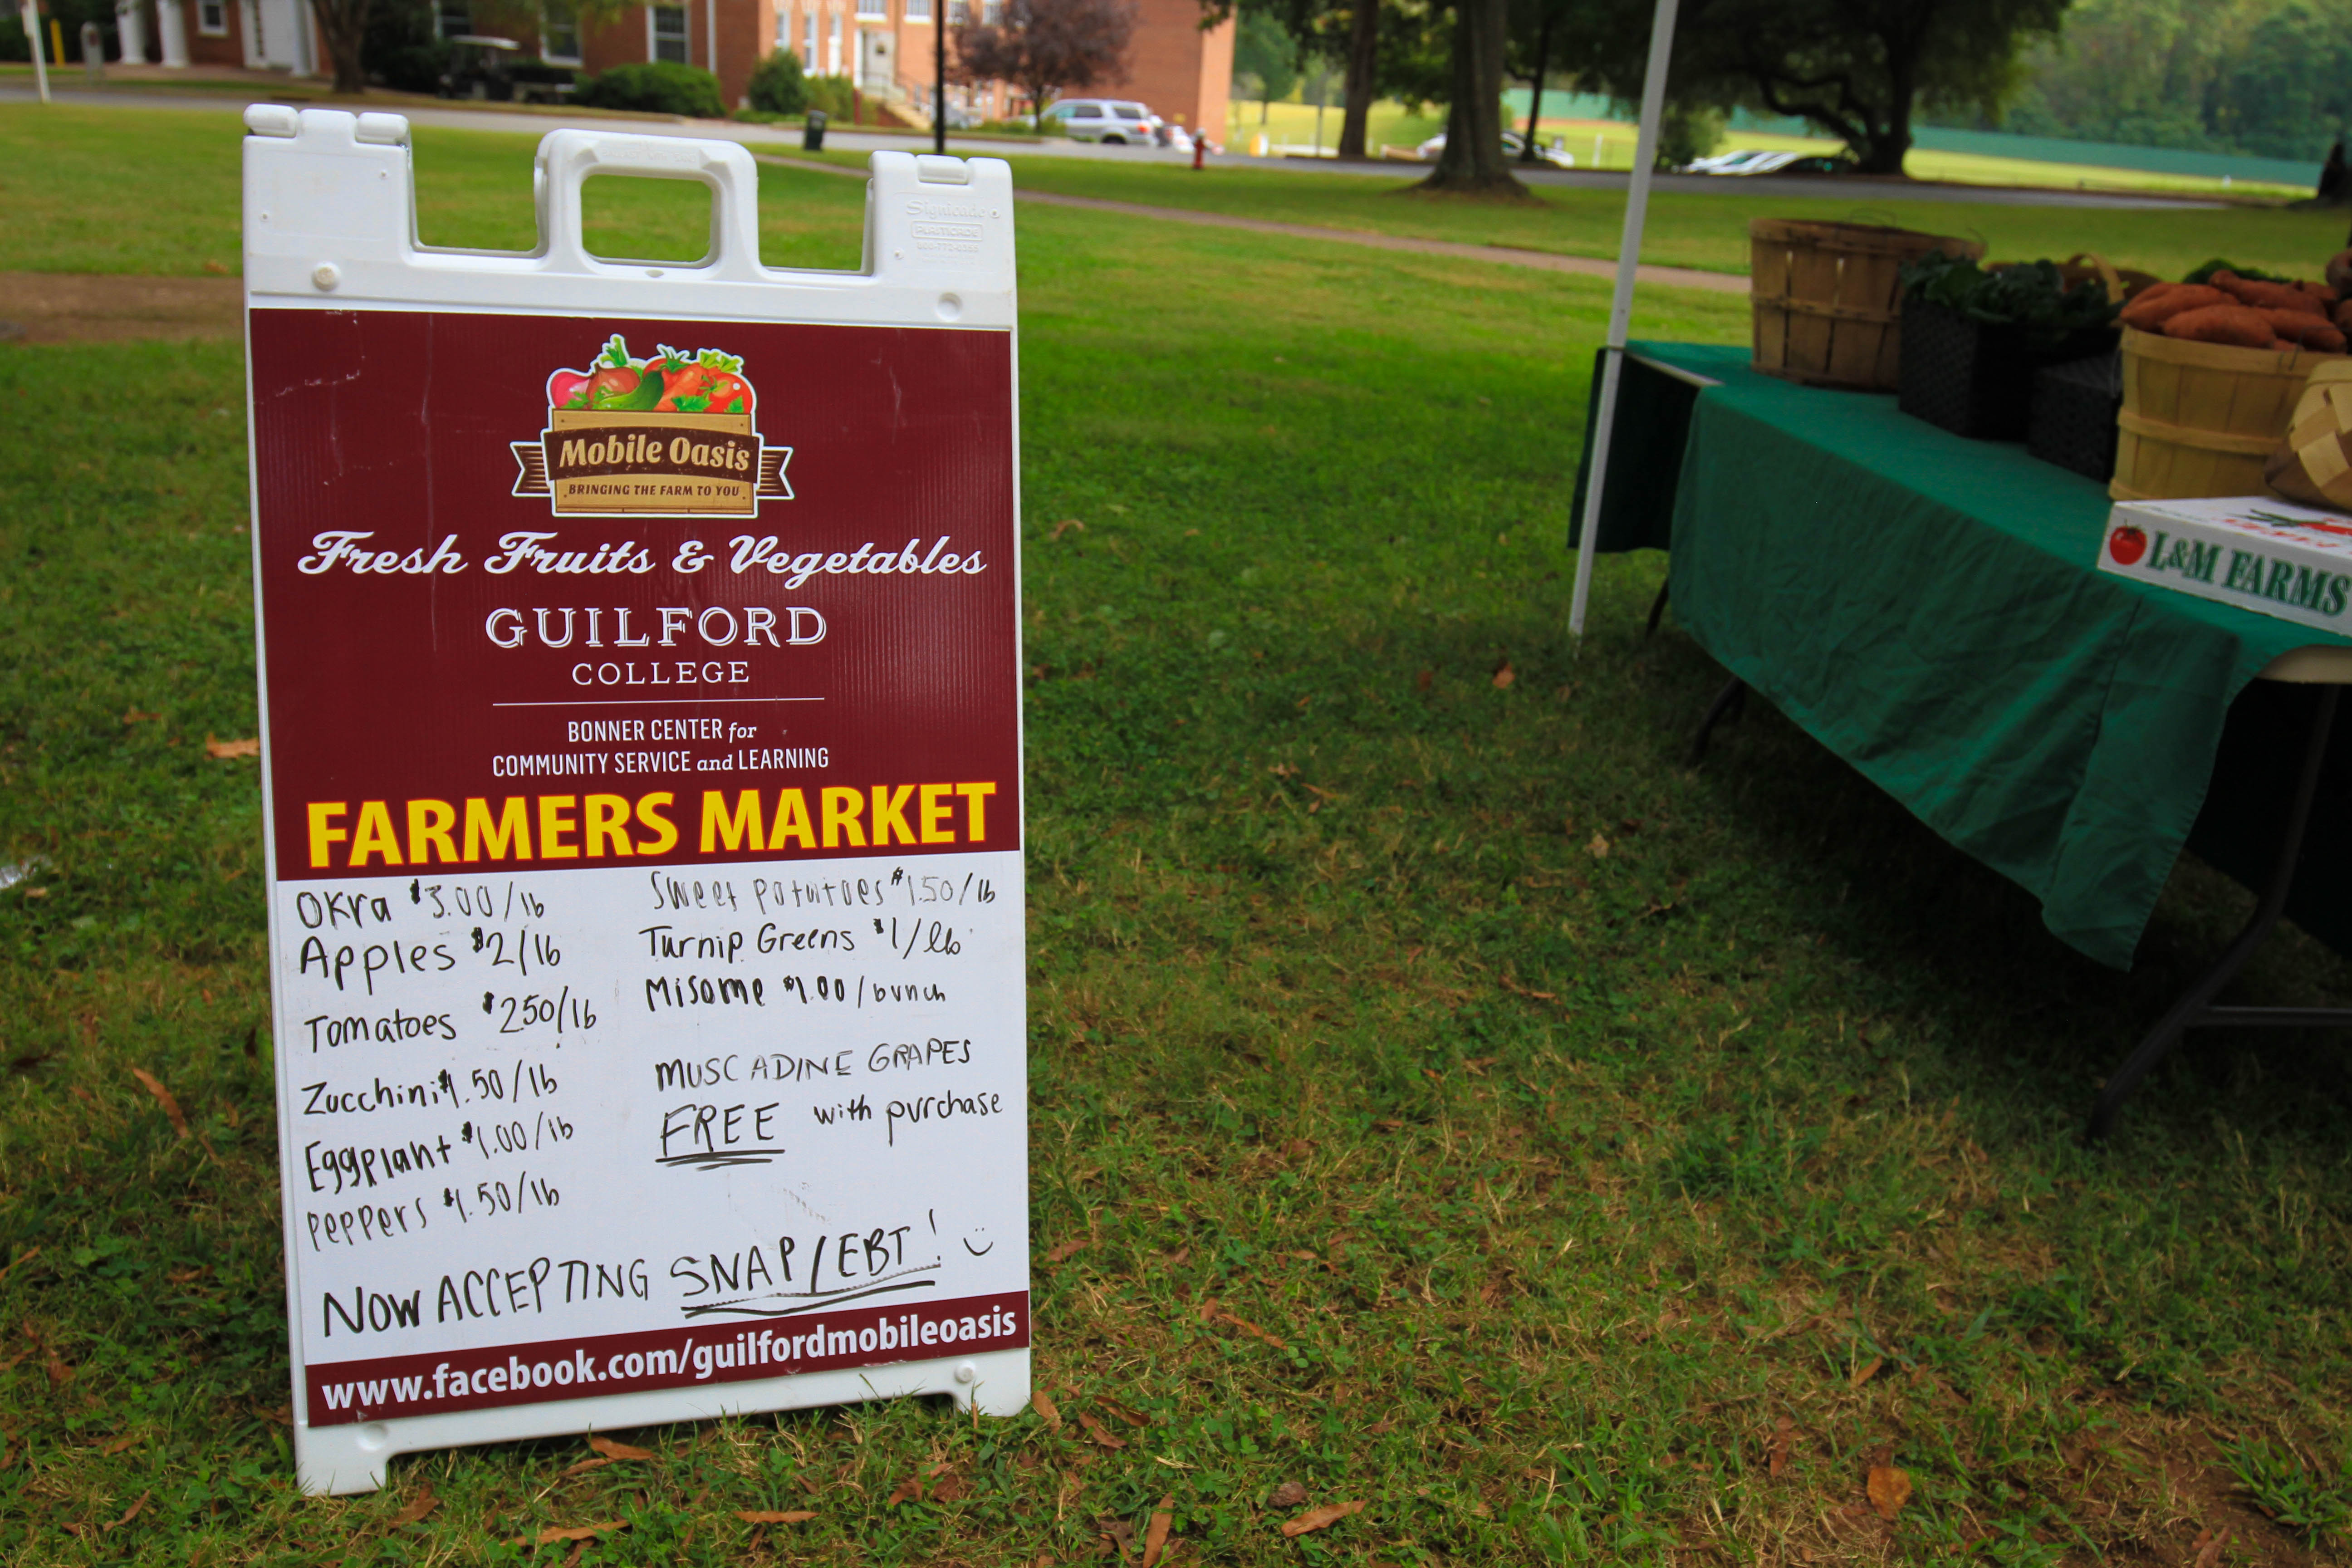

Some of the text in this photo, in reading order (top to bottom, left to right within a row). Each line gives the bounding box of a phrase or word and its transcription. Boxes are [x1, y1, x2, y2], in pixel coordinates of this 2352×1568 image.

[559, 433, 750, 471] Mobile Oasis
[568, 484, 740, 496] BRINGING THE FARM TO YOU
[297, 530, 988, 590] Fresh Fruits & Vegetables
[2146, 530, 2225, 584] L&M
[2220, 548, 2352, 616] FARMS
[485, 606, 827, 648] GUILFORD
[572, 661, 750, 685] COLLEGE
[568, 719, 757, 743] BONNER CENTER for
[492, 748, 829, 777] COMMUNITY SERVICE and LEARNING
[307, 781, 996, 868] FARMERS MARKET
[650, 870, 738, 912] Sweet
[639, 925, 744, 964] Turnip
[757, 922, 855, 954] Greens
[300, 936, 456, 995] Apples
[304, 1008, 456, 1053] Tomatoes
[867, 1038, 972, 1073] GRAPES
[659, 1089, 1004, 1157] FREE with purchase
[305, 1135, 451, 1195] Eggplant
[323, 1286, 421, 1338] NOW
[437, 1257, 649, 1323] ACCEPTING
[322, 1305, 1017, 1410] www.facebook.com/guilfordmobileoasis
